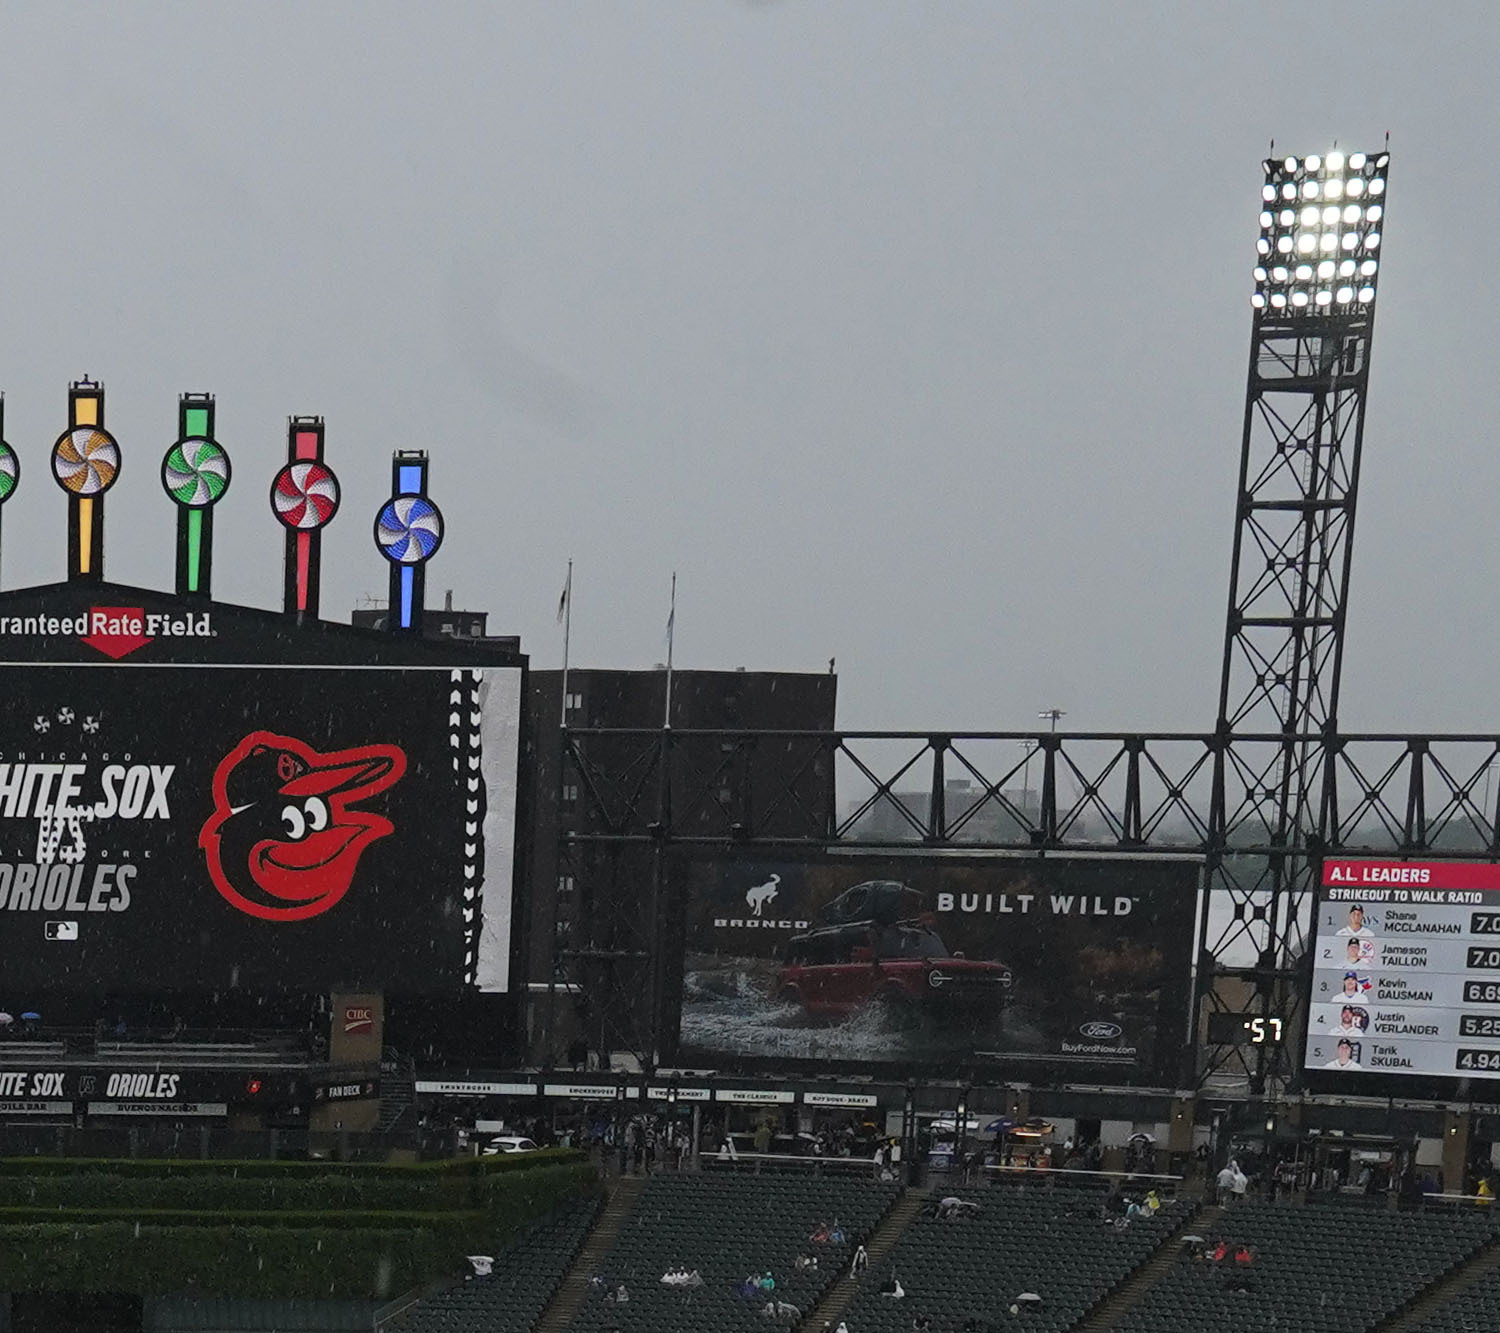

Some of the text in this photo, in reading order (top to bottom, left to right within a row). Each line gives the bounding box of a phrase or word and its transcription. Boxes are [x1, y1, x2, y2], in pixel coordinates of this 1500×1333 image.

[92, 613, 142, 636] Rate
[94, 765, 175, 820] SOX
[1330, 867, 1431, 884] A.L. LEADERS
[1329, 888, 1483, 904] STRIKEOUT TO WALK RATIO
[937, 892, 1134, 917] BUILT WILD
[714, 918, 809, 929] BRONCO
[1384, 921, 1462, 935] MCCLANAHAN
[1380, 955, 1428, 968] TAILLON
[1376, 988, 1434, 1001] GAUSMAN
[1061, 1043, 1137, 1055] BuyFordNow.com
